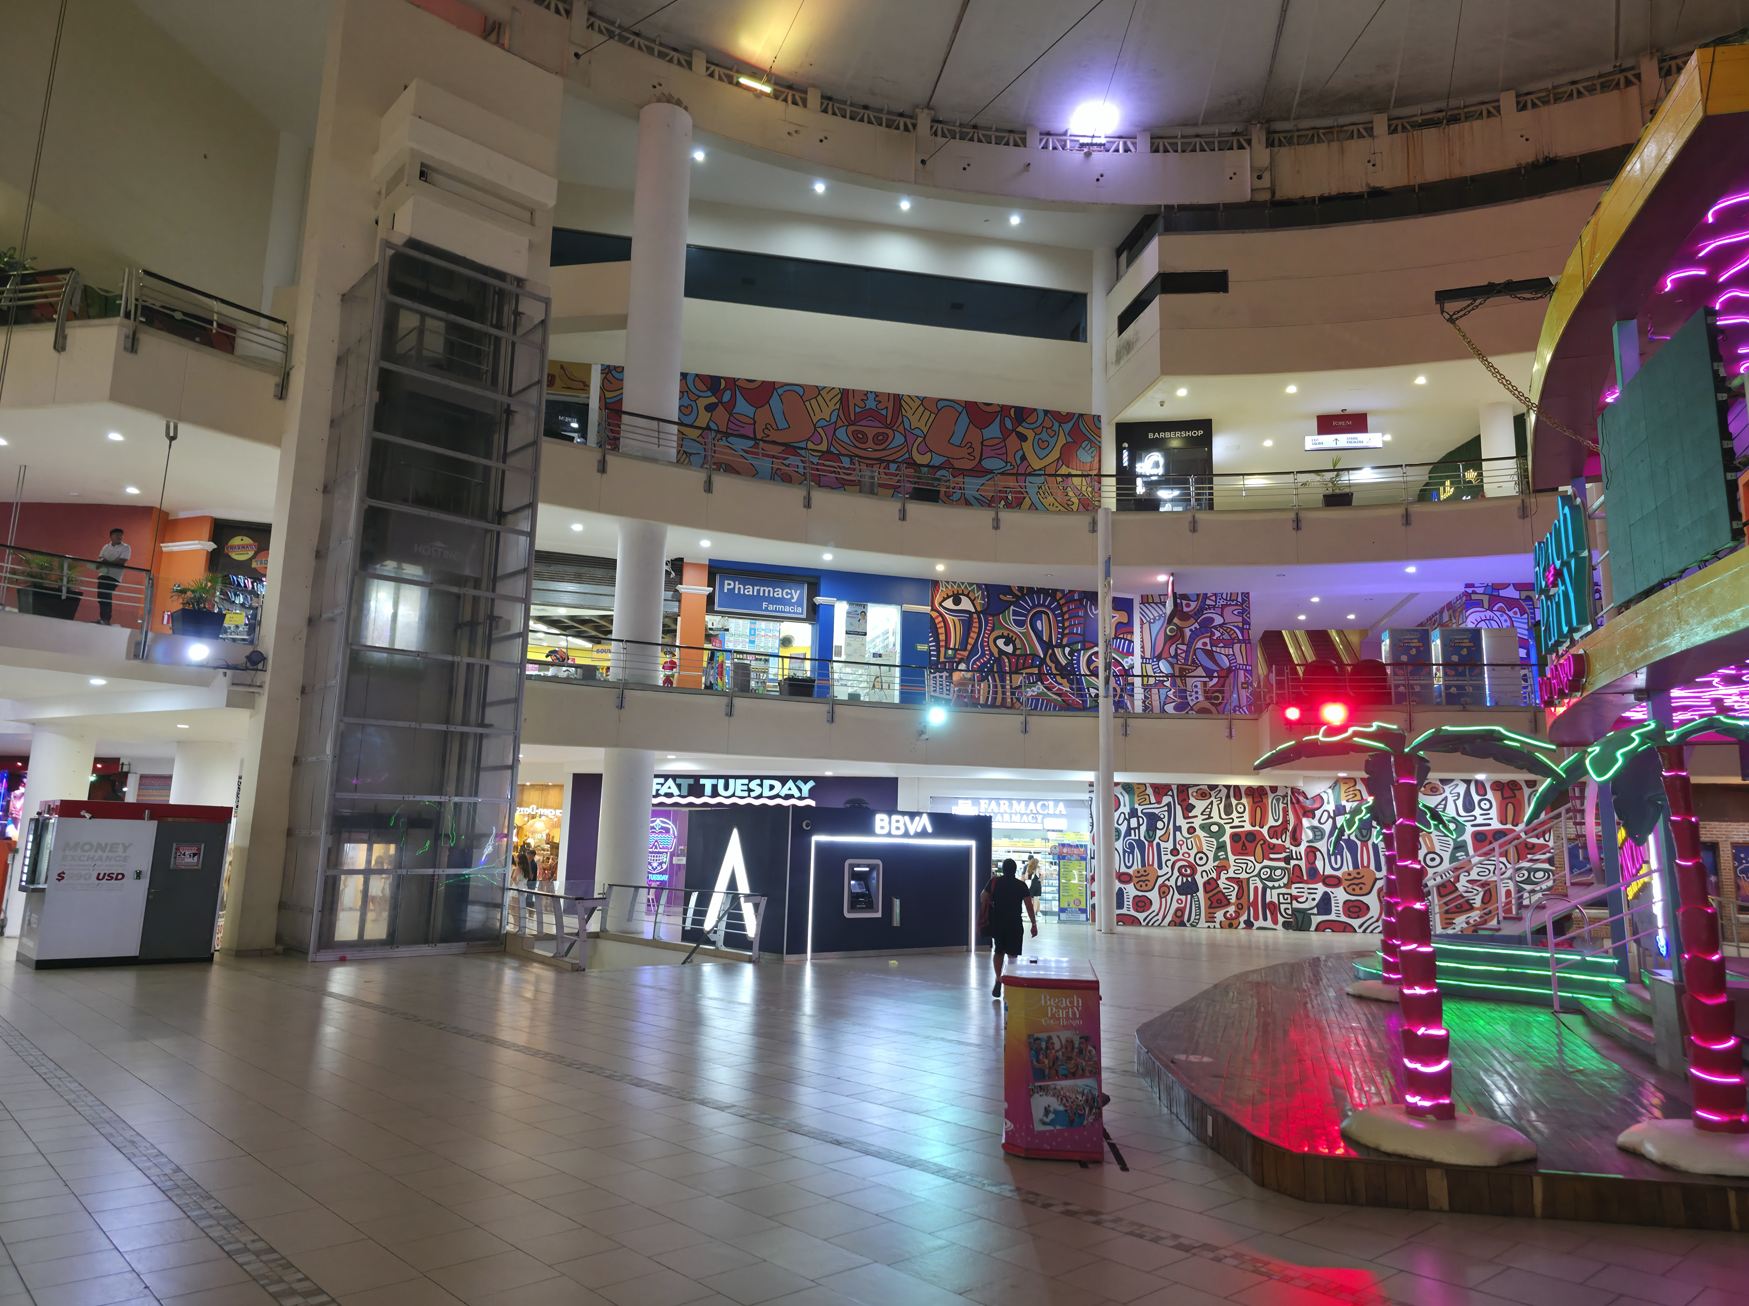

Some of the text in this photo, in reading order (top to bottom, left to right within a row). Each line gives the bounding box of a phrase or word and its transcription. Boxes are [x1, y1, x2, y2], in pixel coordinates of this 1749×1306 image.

[1148, 430, 1204, 439] BARBERSHOP
[724, 580, 800, 602] Pharmacy
[762, 602, 802, 613] Farmacia
[652, 778, 816, 798] FAT TUESDAY
[979, 800, 1066, 814] FARMACIA
[874, 813, 933, 836] BBVA
[62, 842, 132, 854] MONEY
[96, 872, 125, 881] USD
[1041, 992, 1082, 1008] Beach
